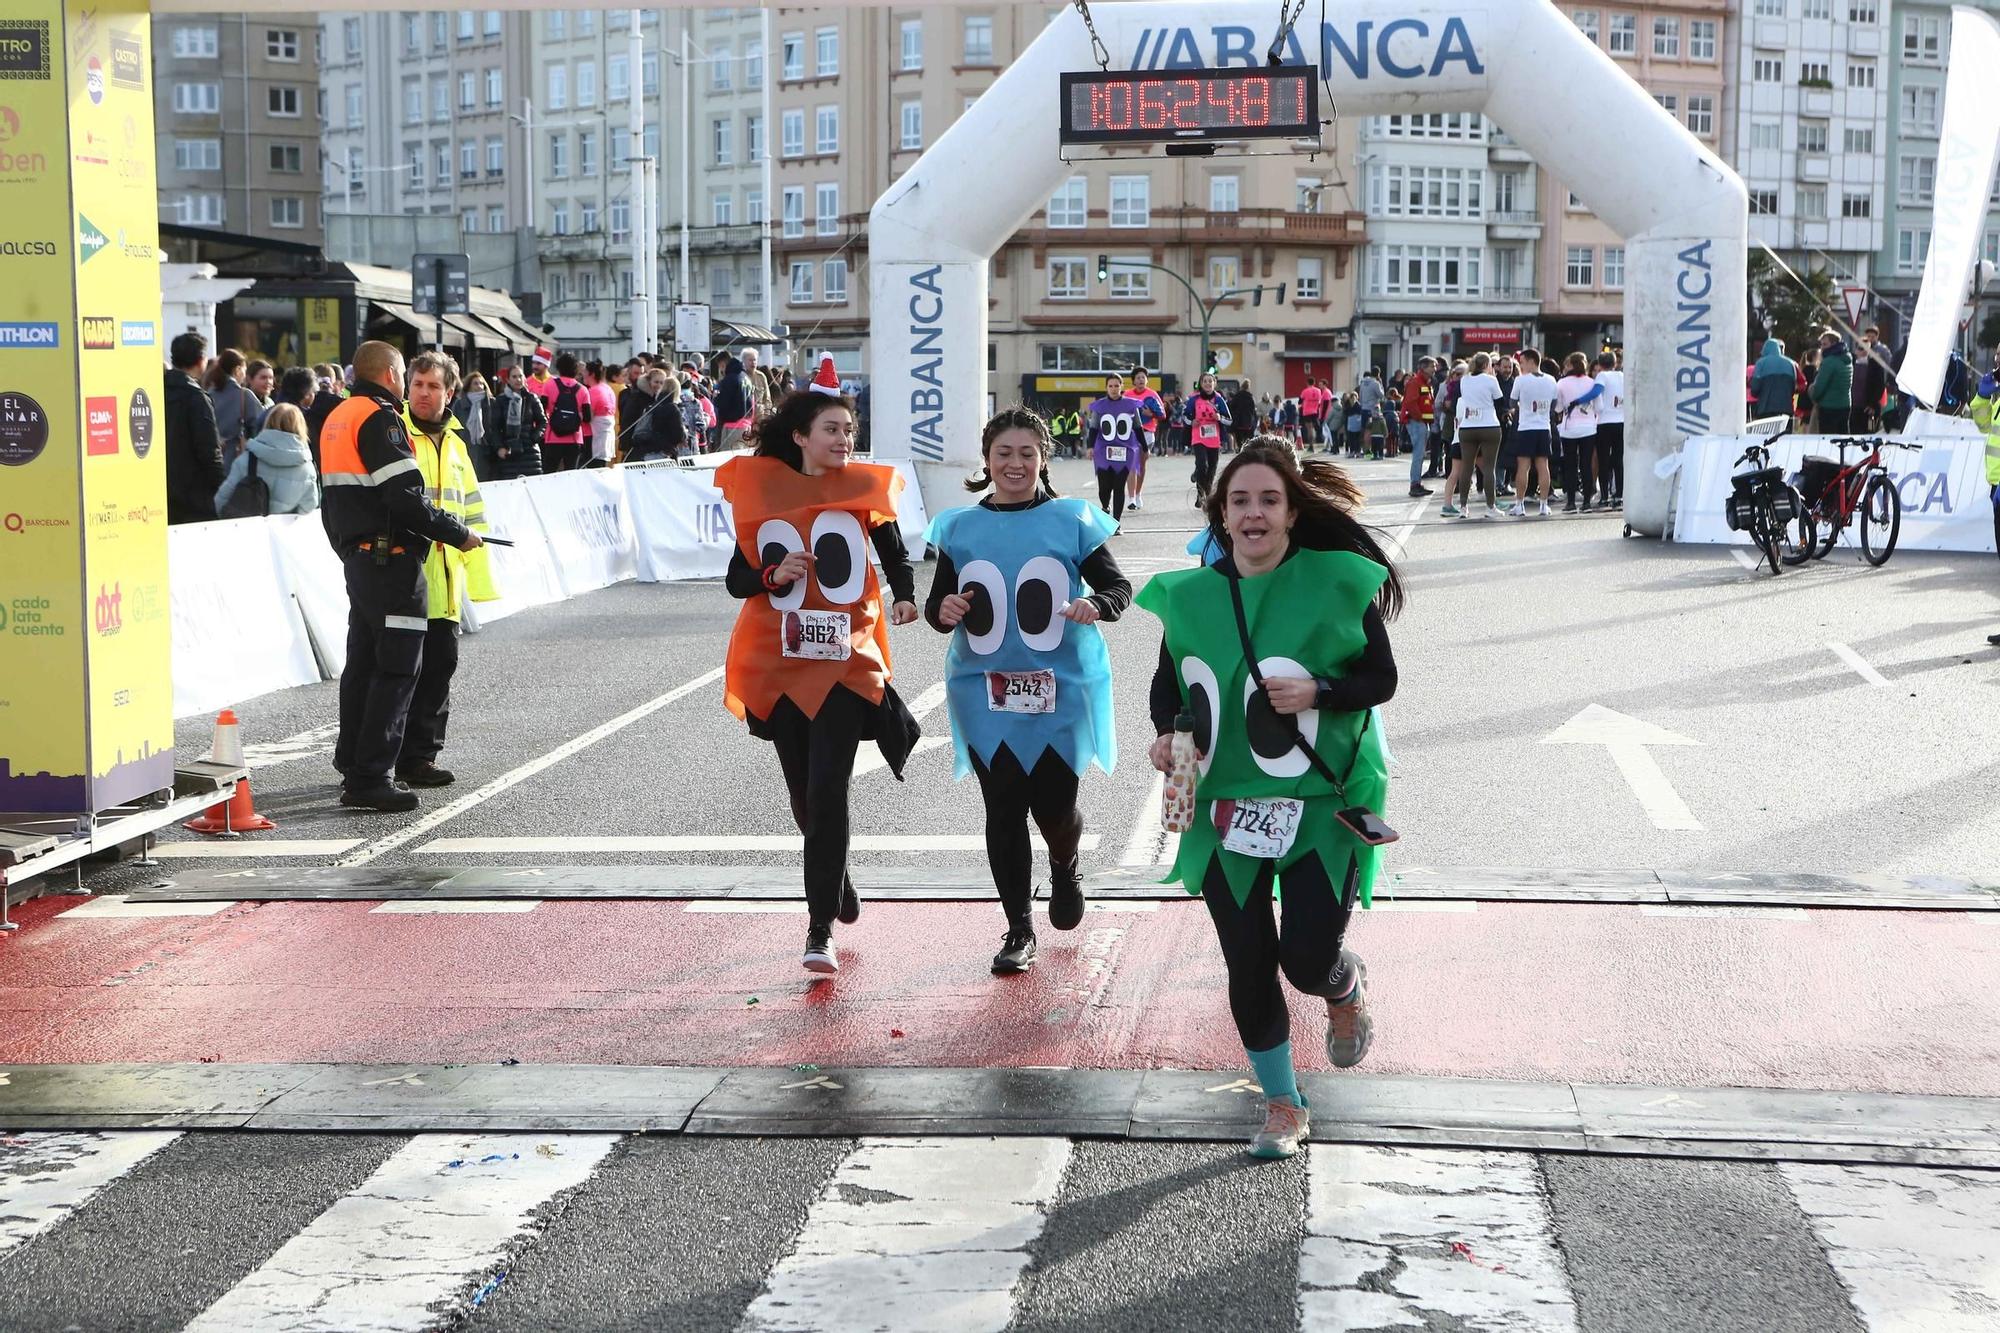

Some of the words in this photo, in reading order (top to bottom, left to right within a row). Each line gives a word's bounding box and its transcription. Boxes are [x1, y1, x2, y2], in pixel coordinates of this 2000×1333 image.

[4, 399, 21, 409] EL
[25, 519, 70, 527] BARCELONA
[12, 596, 50, 609] cada
[13, 609, 41, 623] lata
[13, 624, 64, 636] cuenta
[1234, 806, 1271, 837] 724
